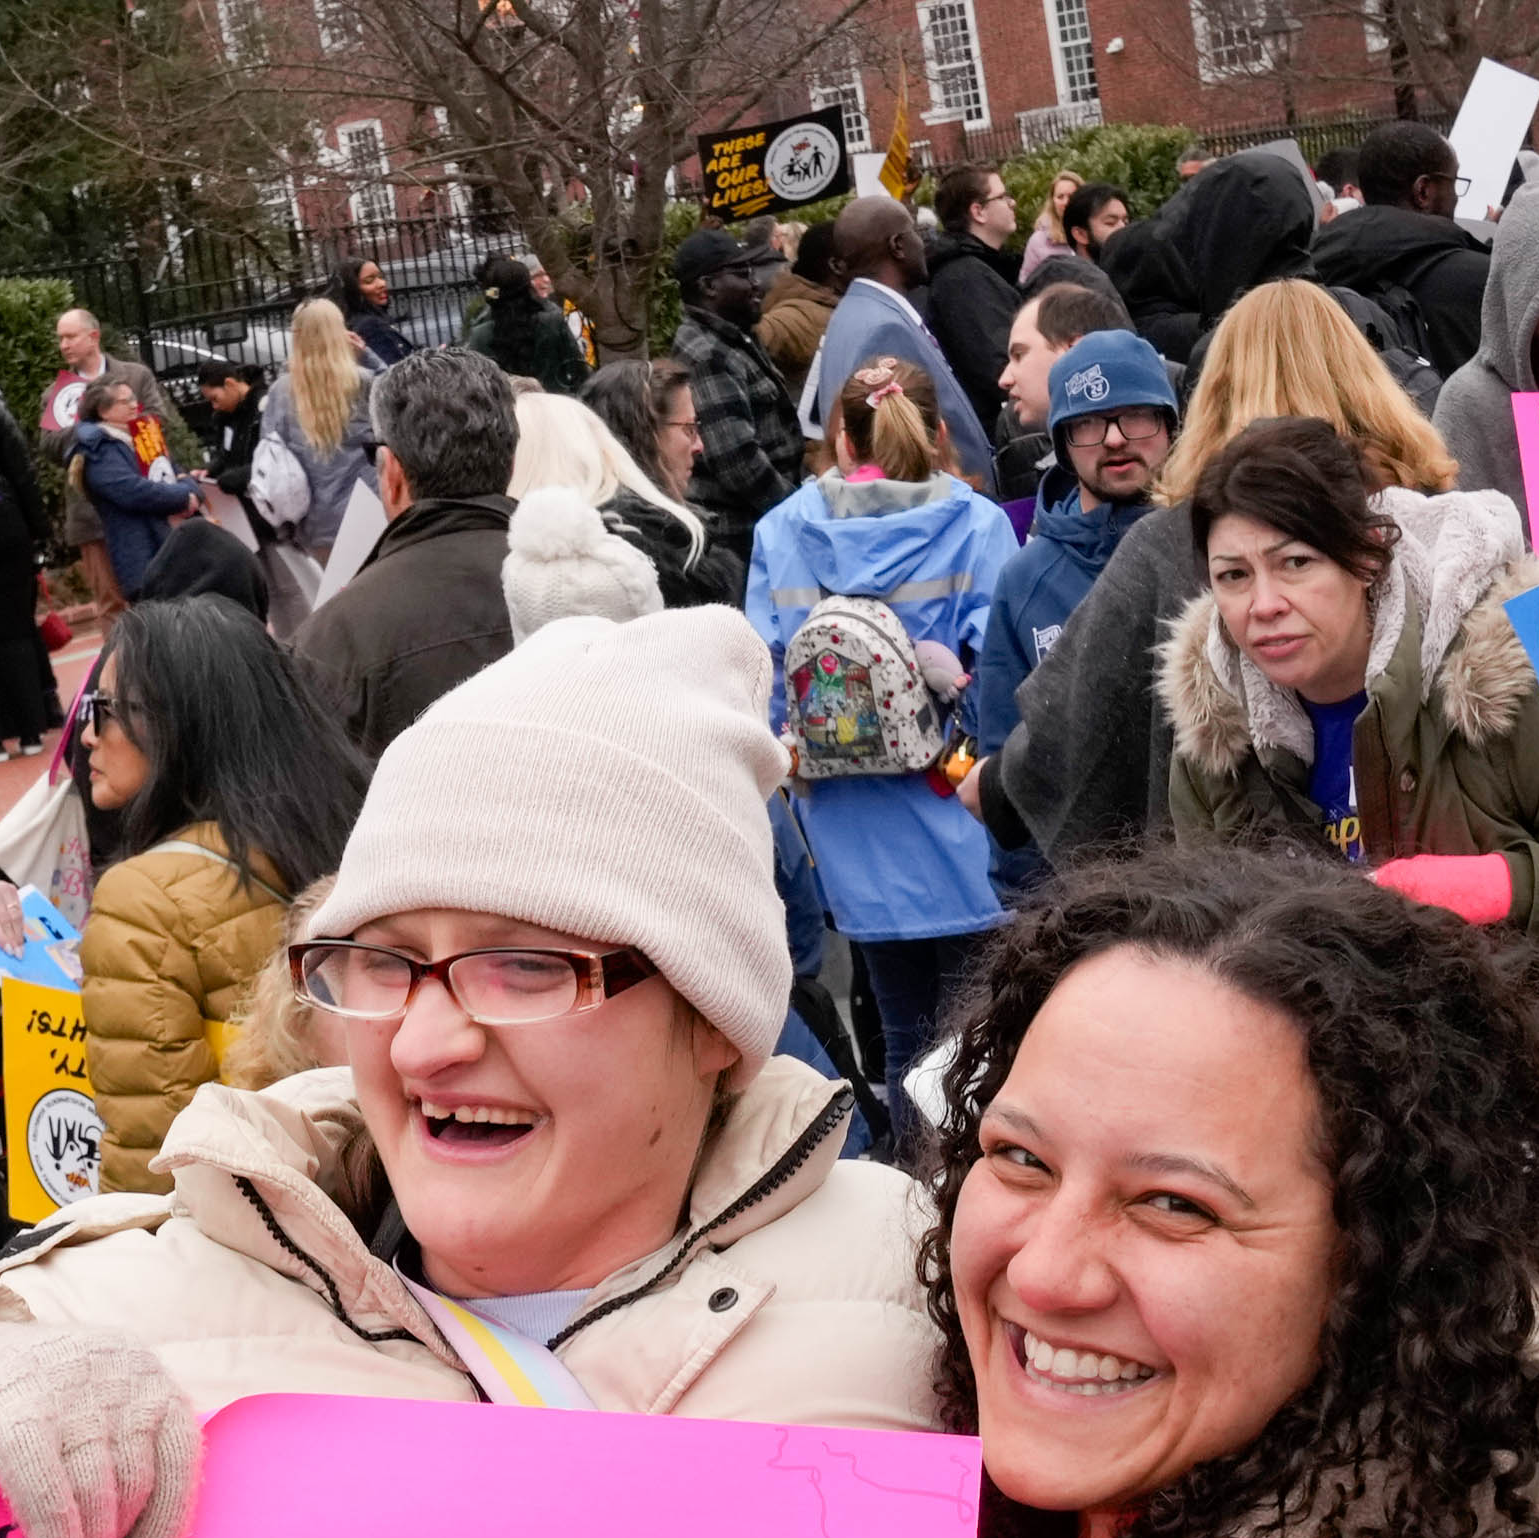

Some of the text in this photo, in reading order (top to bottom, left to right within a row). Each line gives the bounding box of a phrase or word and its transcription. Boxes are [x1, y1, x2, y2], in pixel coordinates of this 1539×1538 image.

[712, 132, 766, 157] THESE
[706, 153, 742, 174] ARE
[717, 163, 759, 189] OUR
[712, 175, 773, 208] LIVES!
